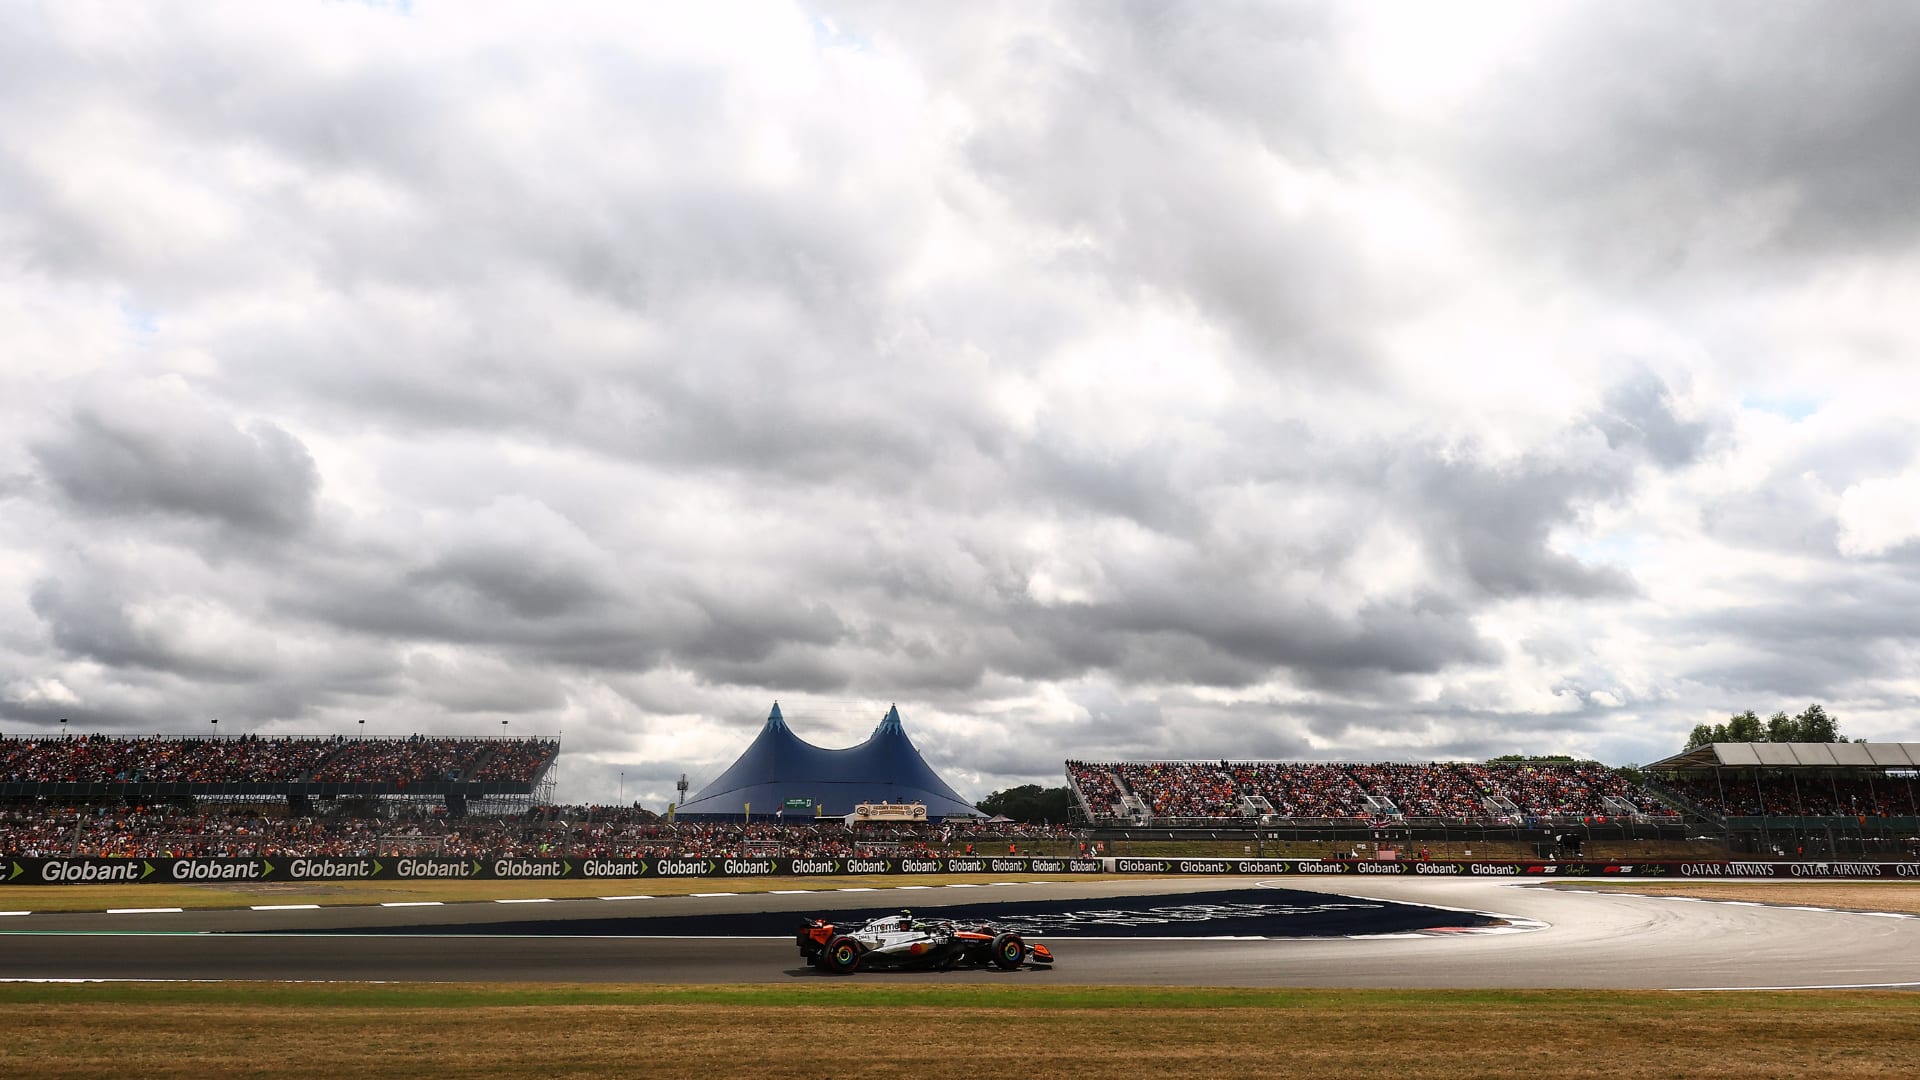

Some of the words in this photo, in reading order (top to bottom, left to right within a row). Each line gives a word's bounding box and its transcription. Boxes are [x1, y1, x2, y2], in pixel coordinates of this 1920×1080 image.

[42, 861, 137, 881] Globant
[173, 860, 259, 879] Globant
[291, 859, 369, 878] Globant
[397, 859, 469, 877] Globant
[495, 859, 560, 876] Globant
[583, 859, 638, 876] Globant
[657, 859, 707, 875] Globant
[724, 859, 769, 874] Globant
[792, 860, 834, 873] Globant
[847, 859, 886, 873] Globant
[902, 859, 937, 872] Globant
[949, 859, 981, 872] Globant
[992, 859, 1023, 872] Globant
[1032, 860, 1062, 872] Globant
[1070, 860, 1097, 872] Globant
[1120, 860, 1165, 873] Globant
[1180, 861, 1224, 873] Globant
[1239, 861, 1283, 873] Globant
[1298, 861, 1342, 873] Globant
[1357, 862, 1401, 874] Globant
[1416, 862, 1457, 875] Globant
[1471, 863, 1515, 875] Globant
[1681, 863, 1721, 876] QATAR
[1724, 863, 1775, 876] AIRWAYS
[1790, 864, 1830, 877] QATAR
[1832, 864, 1881, 876] AIRWAYS
[864, 923, 899, 933] Chrome
